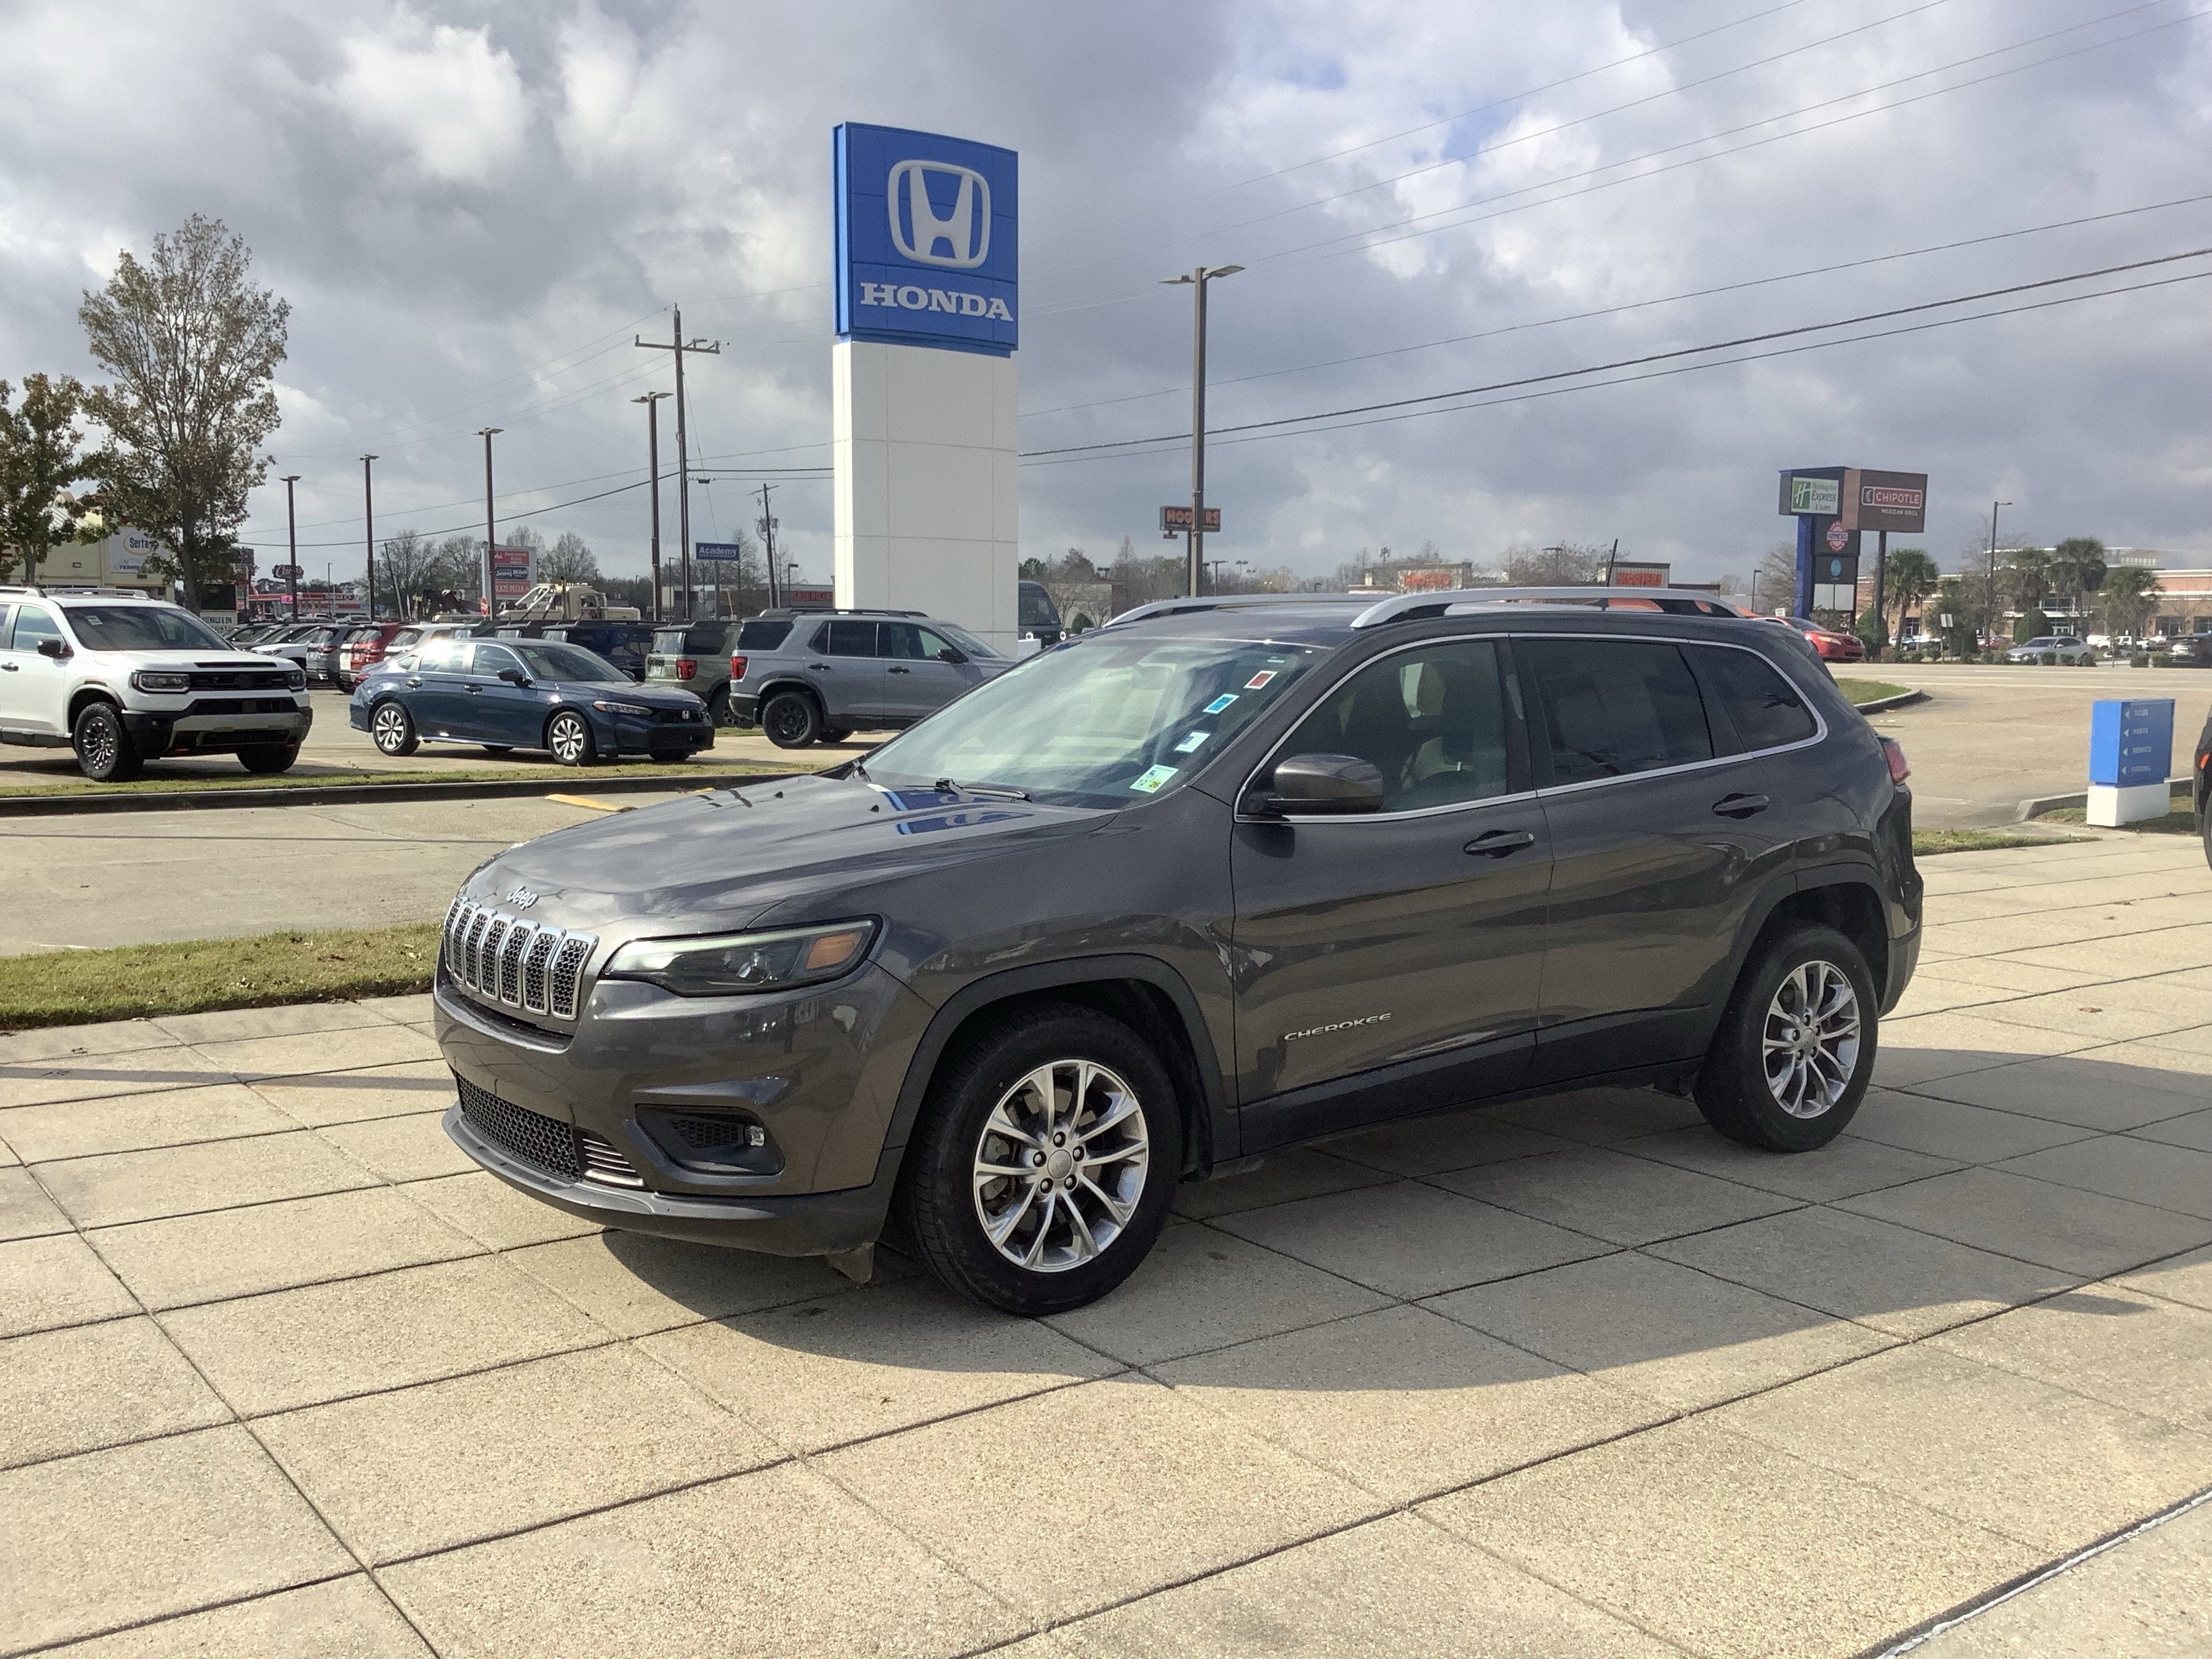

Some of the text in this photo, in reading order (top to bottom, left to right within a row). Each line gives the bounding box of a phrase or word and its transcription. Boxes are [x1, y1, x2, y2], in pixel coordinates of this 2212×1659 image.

[860, 282, 1014, 323] HONDA
[1811, 490, 1837, 504] Express
[1876, 491, 1920, 504] CHIPOTLE
[1166, 509, 1219, 525] HOORS
[129, 537, 149, 548] Serta
[699, 546, 737, 556] Academy
[506, 885, 539, 911] Jeep
[1284, 1012, 1391, 1041] CHEROKEE
